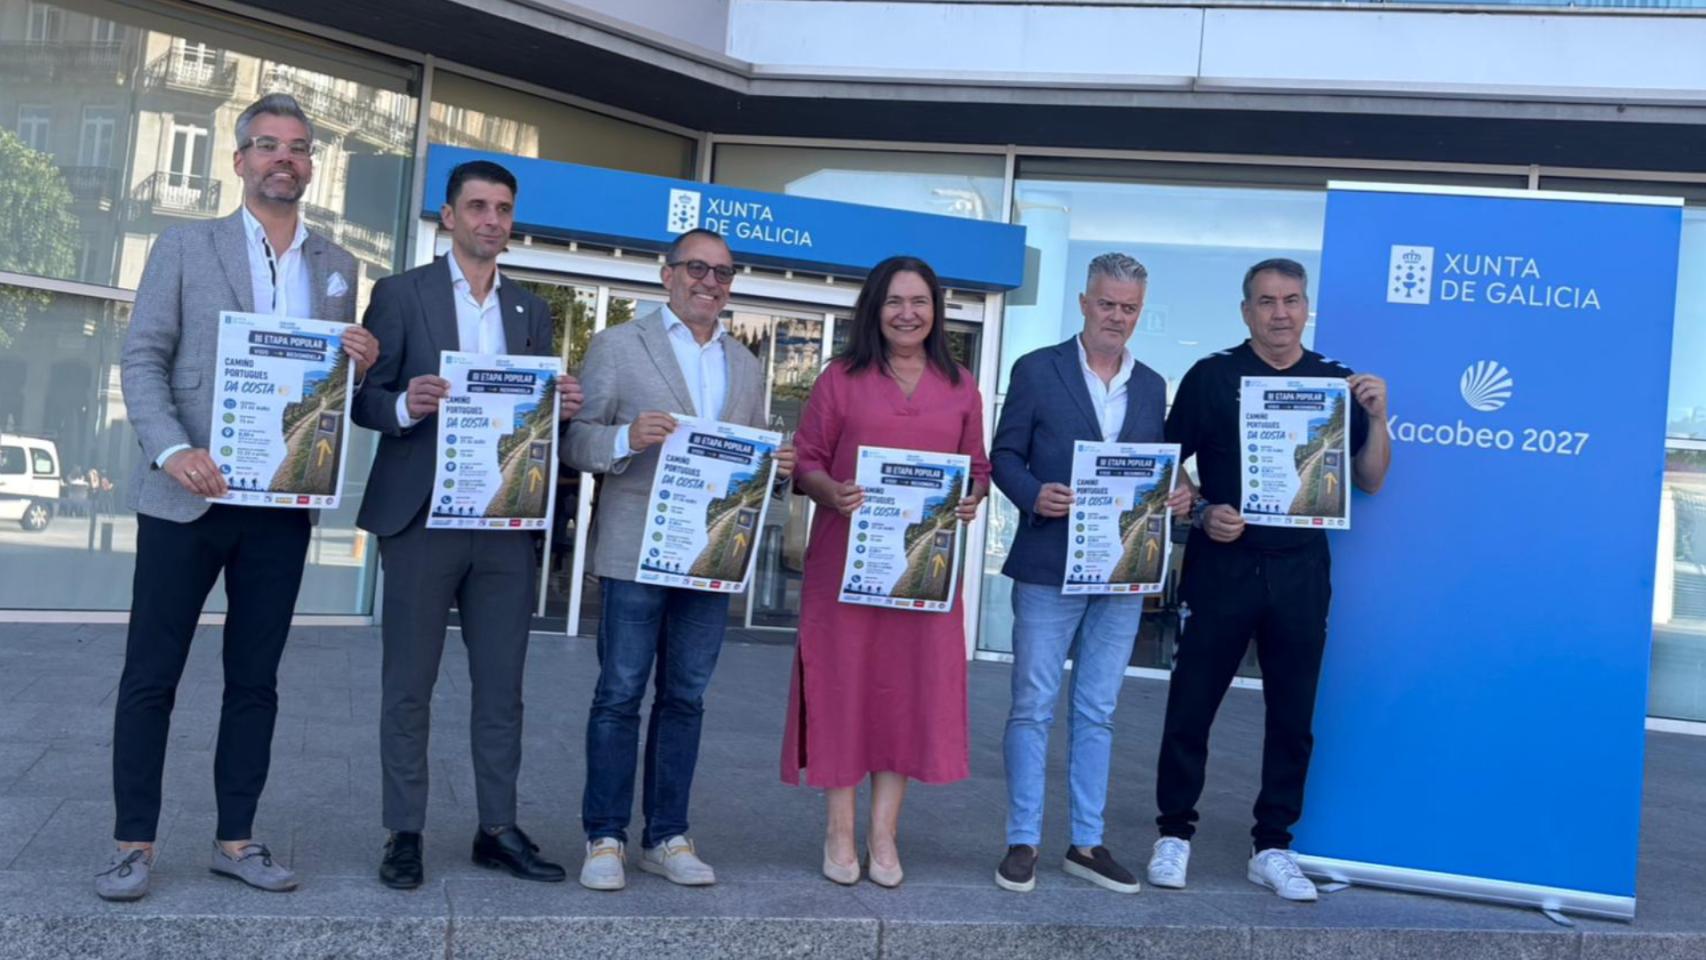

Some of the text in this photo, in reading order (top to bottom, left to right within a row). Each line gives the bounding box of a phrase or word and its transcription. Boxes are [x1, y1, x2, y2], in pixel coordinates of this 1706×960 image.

[707, 197, 773, 221] XUNTA
[705, 217, 812, 247] DE GALICIA
[1443, 253, 1541, 279] XUNTA
[1440, 279, 1601, 310] DE GALICIA
[264, 335, 288, 345] ETAPA
[290, 337, 323, 348] POPULAR
[286, 351, 322, 360] REDONDELA
[224, 357, 254, 368] CAMIÑO
[480, 373, 502, 382] ETAPA
[503, 374, 533, 383] POPULAR
[224, 380, 275, 394] DA COSTA
[446, 417, 489, 428] DA COSTA
[1247, 431, 1286, 440] DA COSTA
[701, 436, 722, 448] ETAPA
[724, 441, 752, 453] POPULAR
[1521, 428, 1590, 456] 2027
[1107, 459, 1126, 467] ETAPA
[1127, 459, 1153, 467] POPULAR
[893, 466, 913, 476] ETAPA
[914, 468, 941, 478] POPULAR
[661, 474, 705, 489] DA COSTA
[1075, 496, 1113, 506] DA COSTA
[859, 505, 901, 517] DA COSTA
